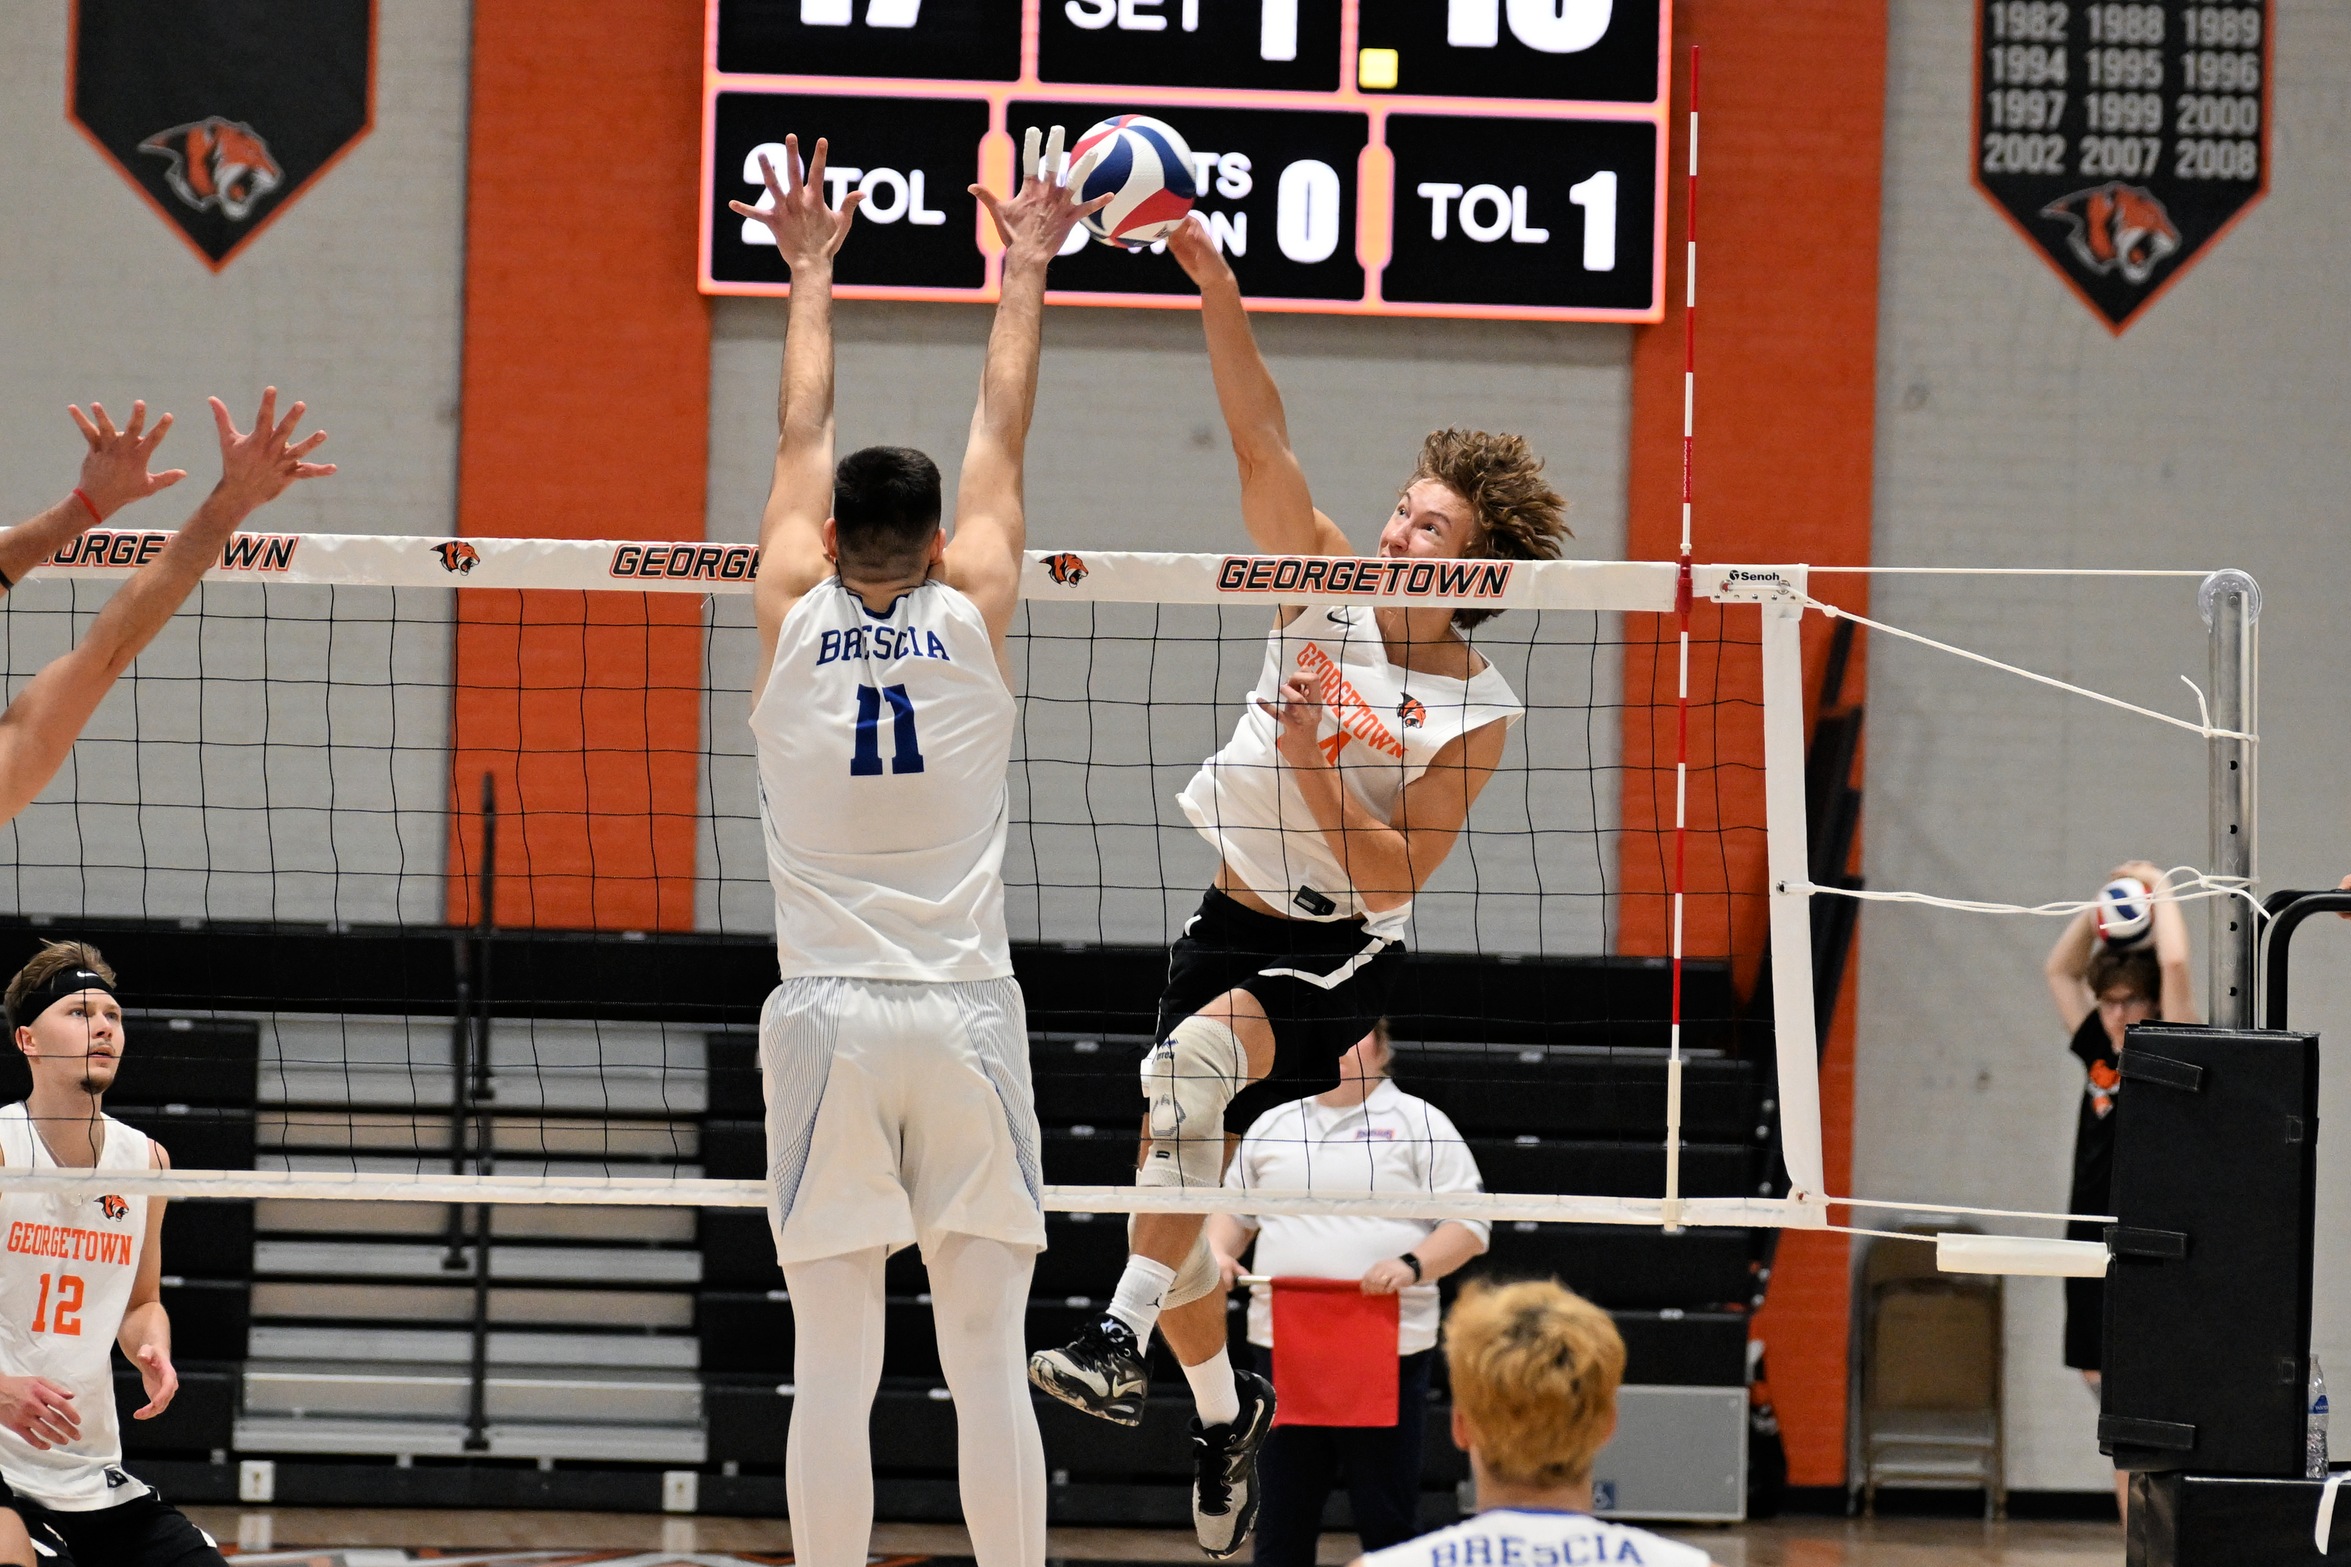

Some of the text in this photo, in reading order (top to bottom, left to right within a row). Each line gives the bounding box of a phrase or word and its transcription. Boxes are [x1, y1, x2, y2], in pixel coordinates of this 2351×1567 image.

[1991, 1, 2260, 46] 1982 1988 1989
[1991, 44, 2259, 91] 1994 1995 1996
[1989, 88, 2259, 135] 1997 1999 2000
[1984, 132, 2258, 180] 2002 2007 2008
[823, 167, 946, 225] TOL
[1277, 159, 1340, 263] 0
[1417, 170, 1617, 271] TOL 1
[1216, 555, 1513, 597] GEORGETOWN
[1741, 572, 1780, 581] Senoh
[816, 626, 950, 666] BRESCIA
[850, 683, 924, 776] 11
[7, 1221, 132, 1266] GEORGETOWN
[31, 1273, 85, 1336] 12
[1431, 1534, 1643, 1567] BRESCIA
